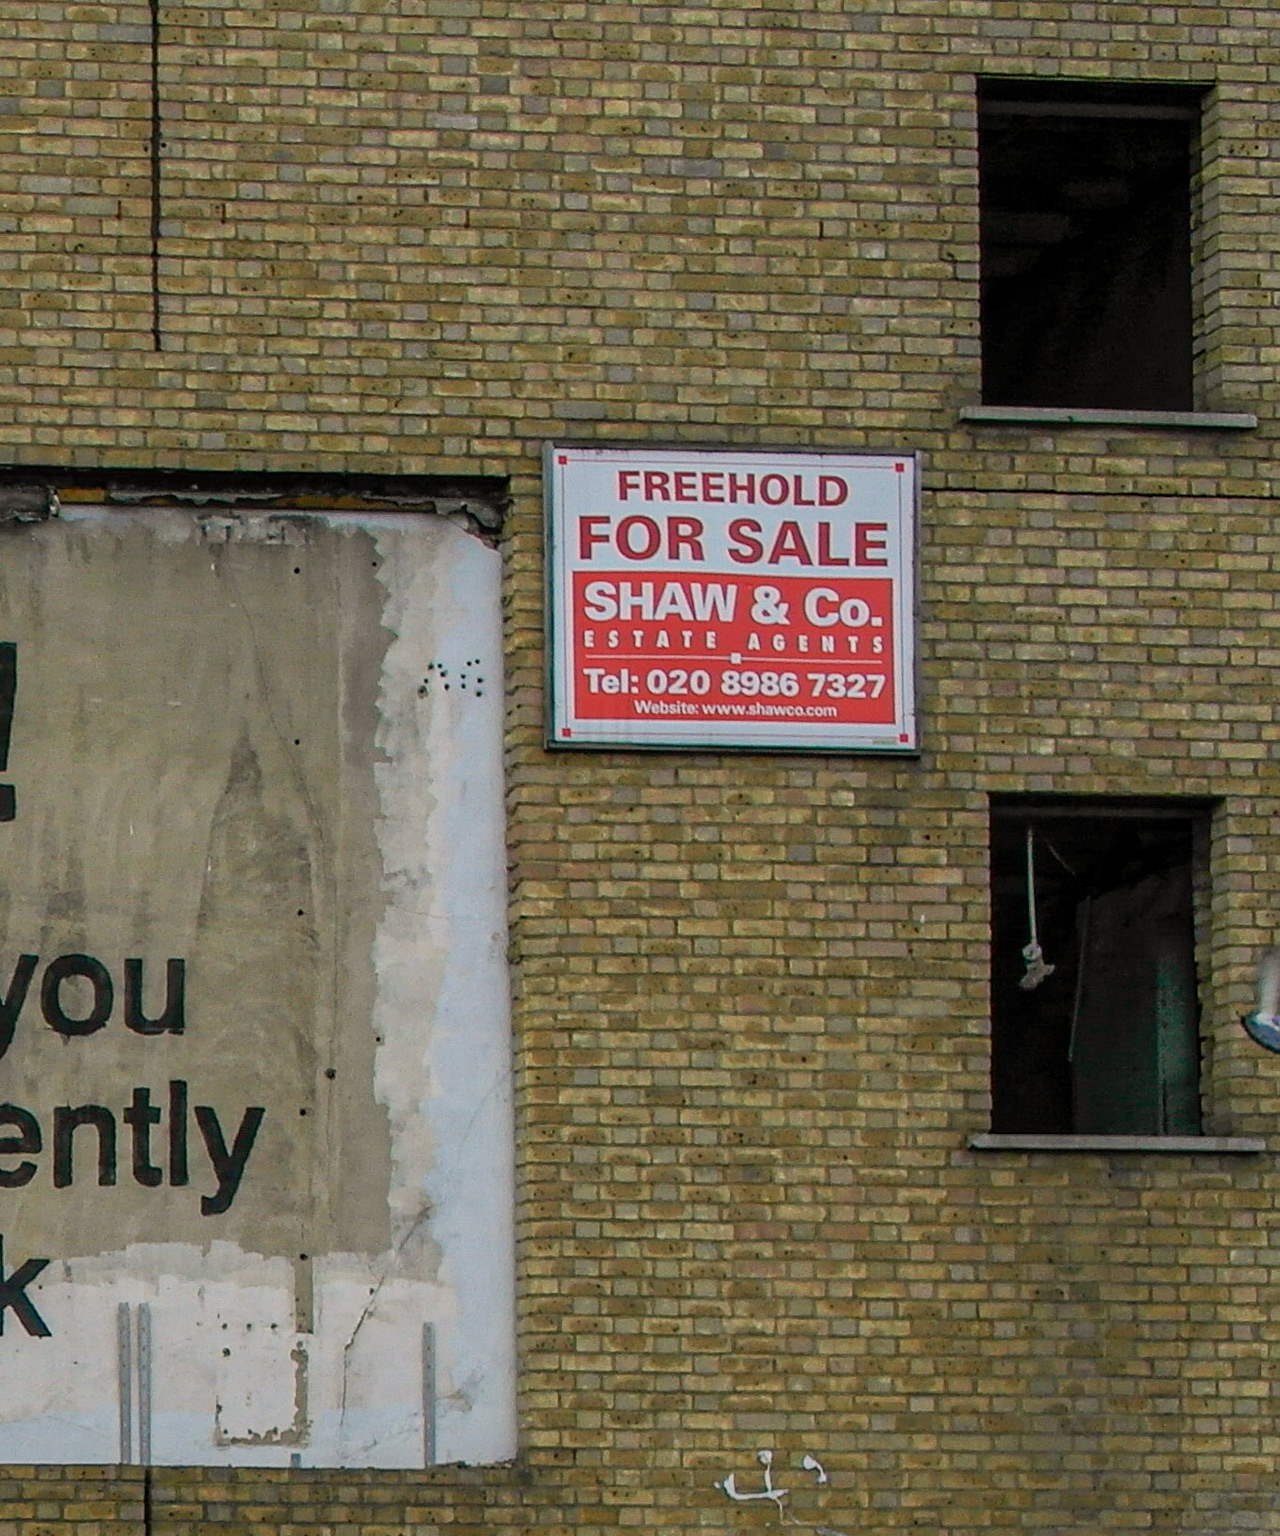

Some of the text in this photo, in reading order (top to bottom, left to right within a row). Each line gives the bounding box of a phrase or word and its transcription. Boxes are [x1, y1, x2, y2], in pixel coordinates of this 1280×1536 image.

[618, 470, 848, 506] FREEHOLD
[578, 515, 888, 567] FOR SALE
[583, 581, 883, 627] SHAW & Co.
[583, 629, 883, 654] ESTATE AGENTS
[583, 668, 886, 699] Tel: 020 8986 7327
[633, 700, 838, 718] Website: www.shawco.com
